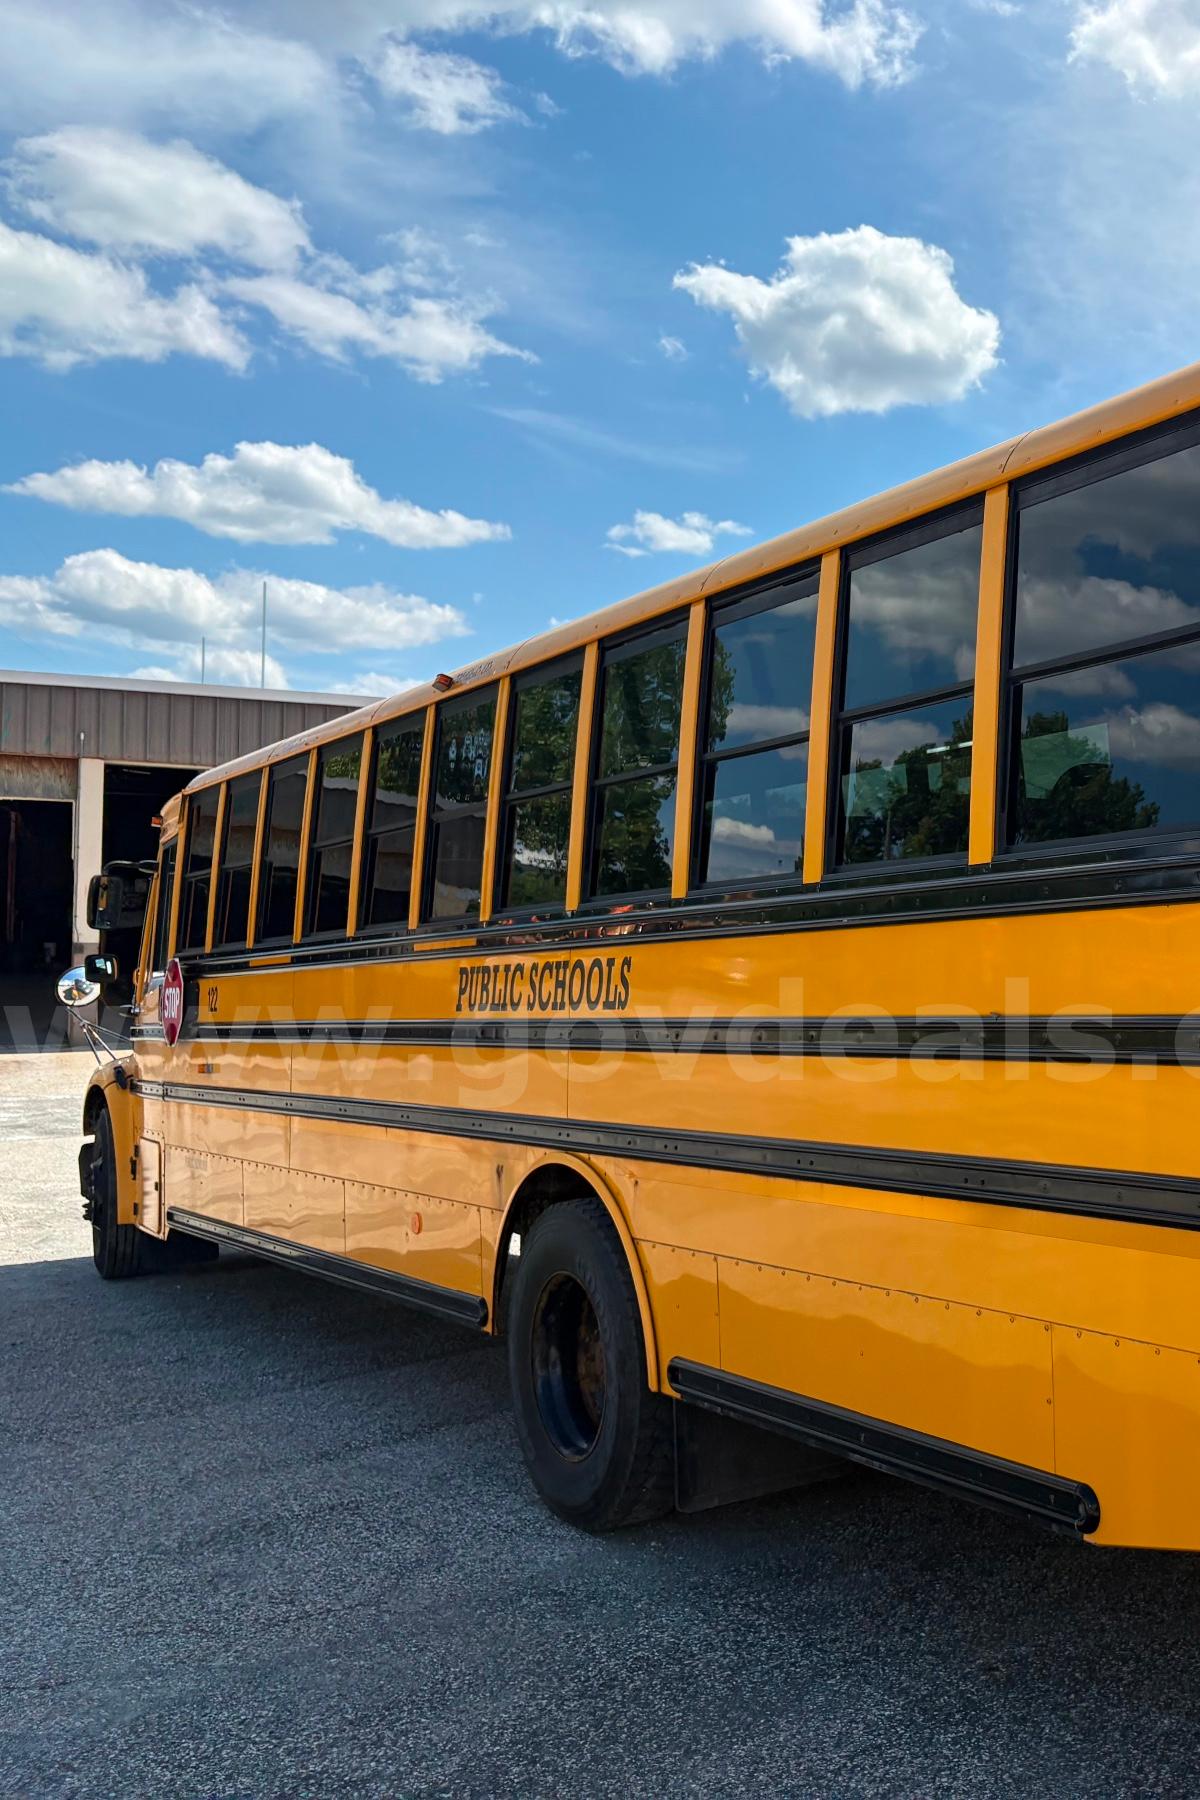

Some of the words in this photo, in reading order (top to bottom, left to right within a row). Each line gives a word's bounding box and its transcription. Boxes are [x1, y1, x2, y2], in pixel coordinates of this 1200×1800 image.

[207, 985, 218, 1013] 122
[456, 962, 525, 1013] PUBLIC
[527, 956, 632, 1012] SCHOOLS
[164, 987, 180, 1019] STOP
